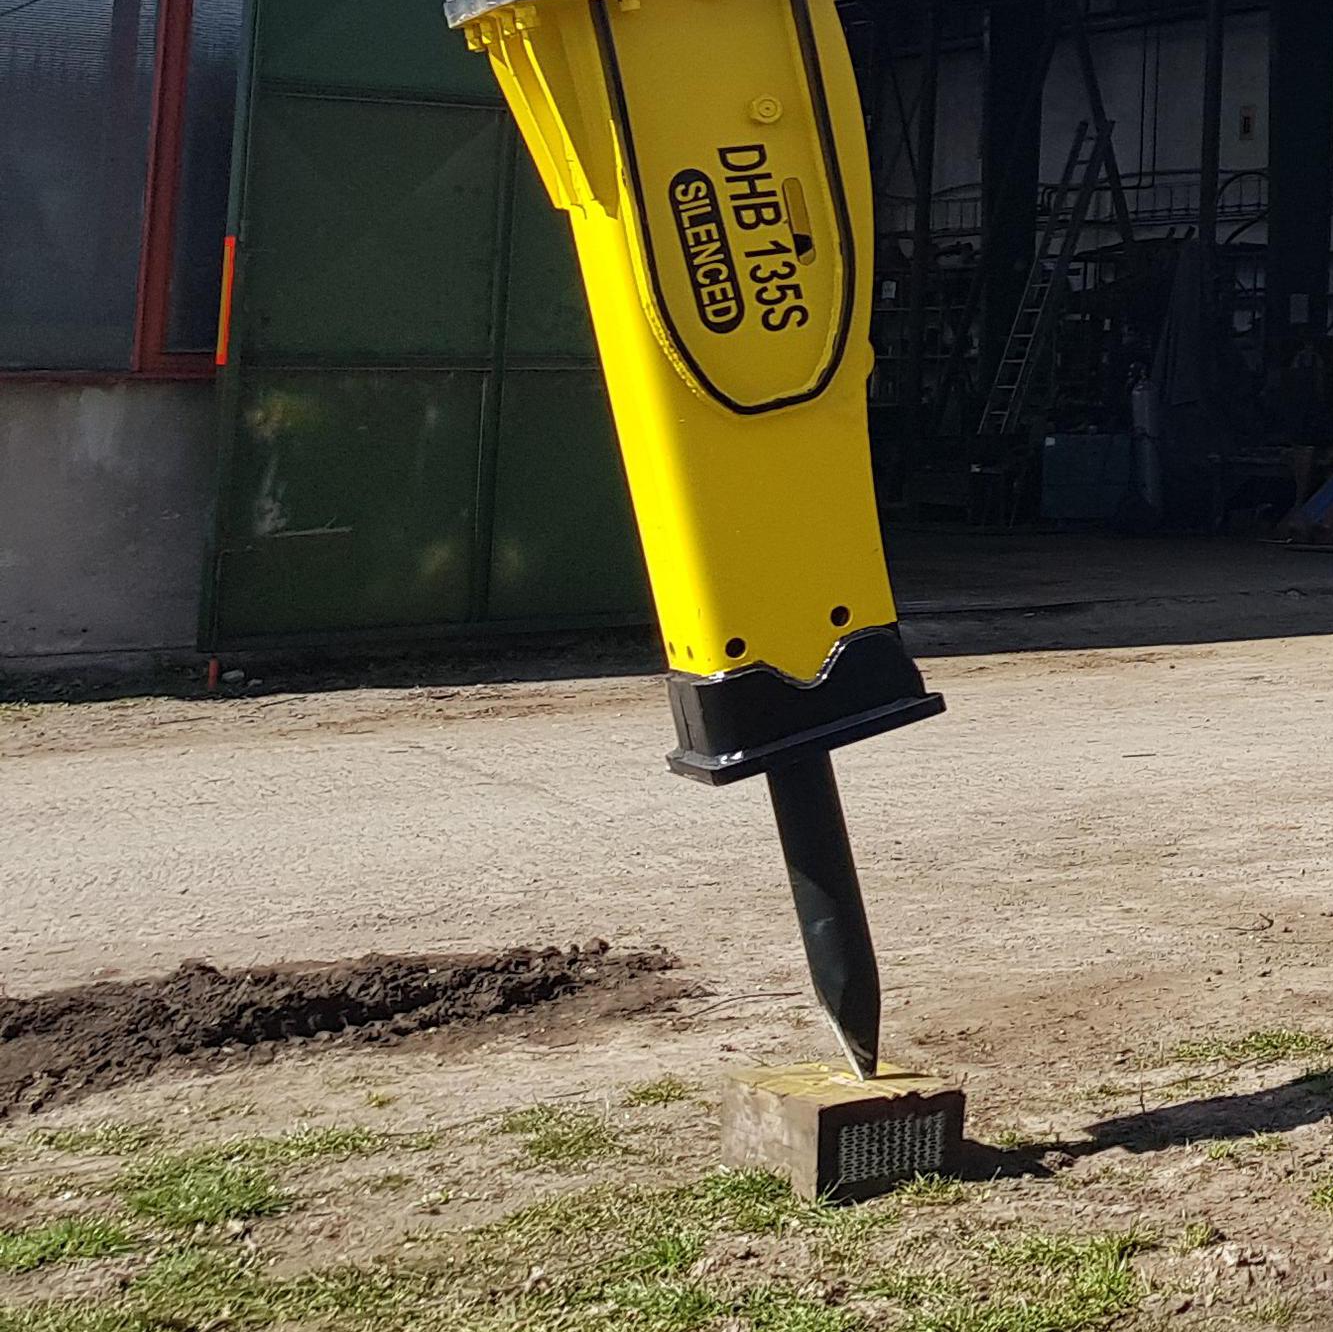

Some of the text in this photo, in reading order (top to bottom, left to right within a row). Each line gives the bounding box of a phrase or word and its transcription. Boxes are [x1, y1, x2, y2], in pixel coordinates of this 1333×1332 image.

[674, 180, 737, 325] SILENCED
[717, 144, 809, 332] DHB 135S
